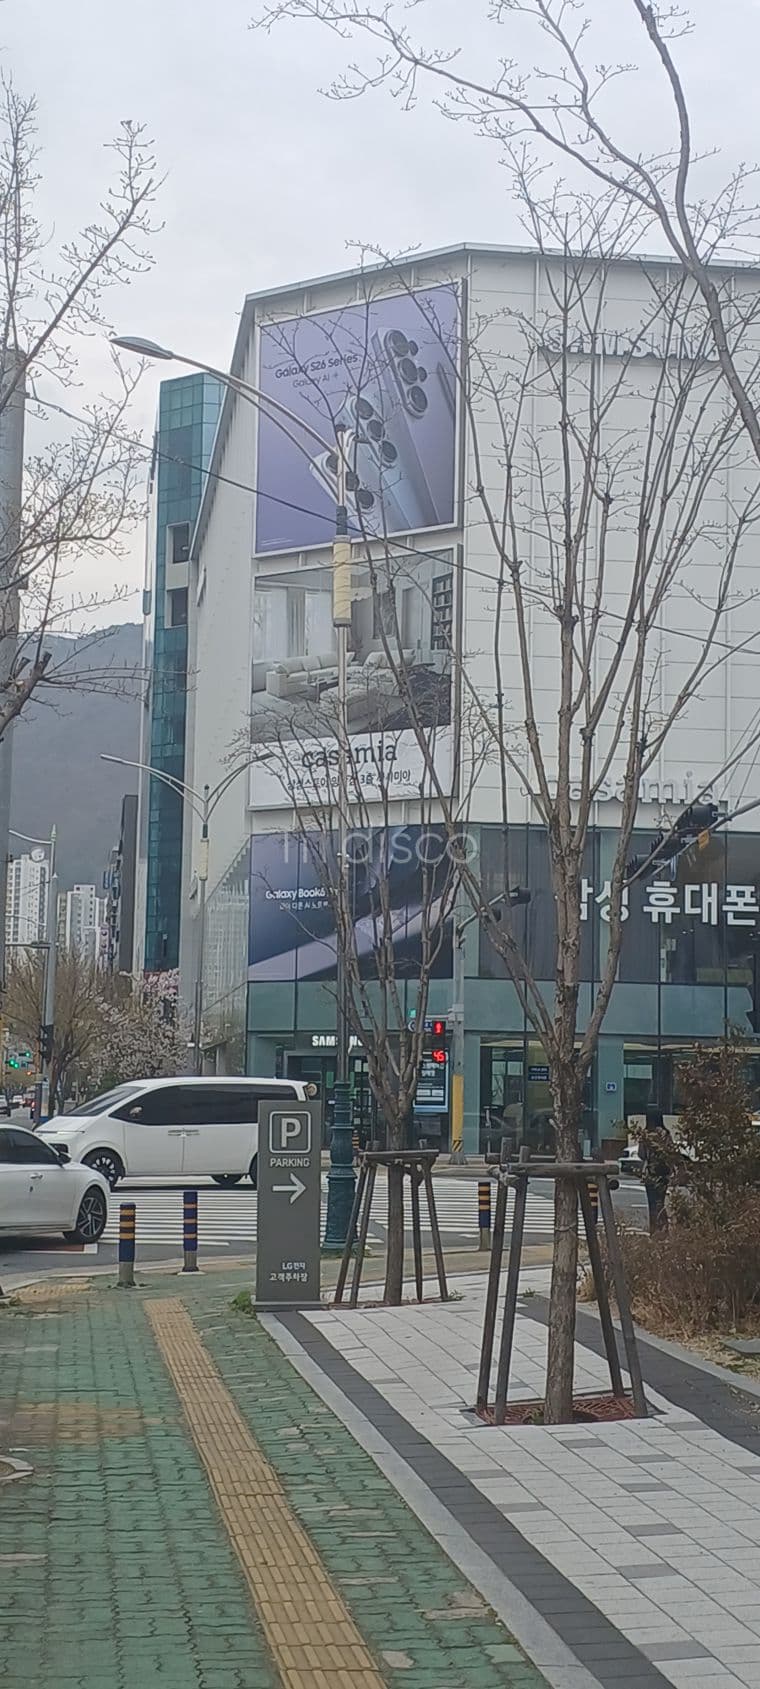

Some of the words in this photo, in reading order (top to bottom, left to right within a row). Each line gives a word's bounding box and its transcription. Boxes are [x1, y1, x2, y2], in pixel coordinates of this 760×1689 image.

[265, 889, 297, 900] Galaxy
[643, 880, 760, 926] 휴대폰
[312, 1035, 364, 1047] SAMN
[281, 1117, 301, 1148] P
[270, 1157, 310, 1168] PARKING
[282, 1262, 293, 1270] LG
